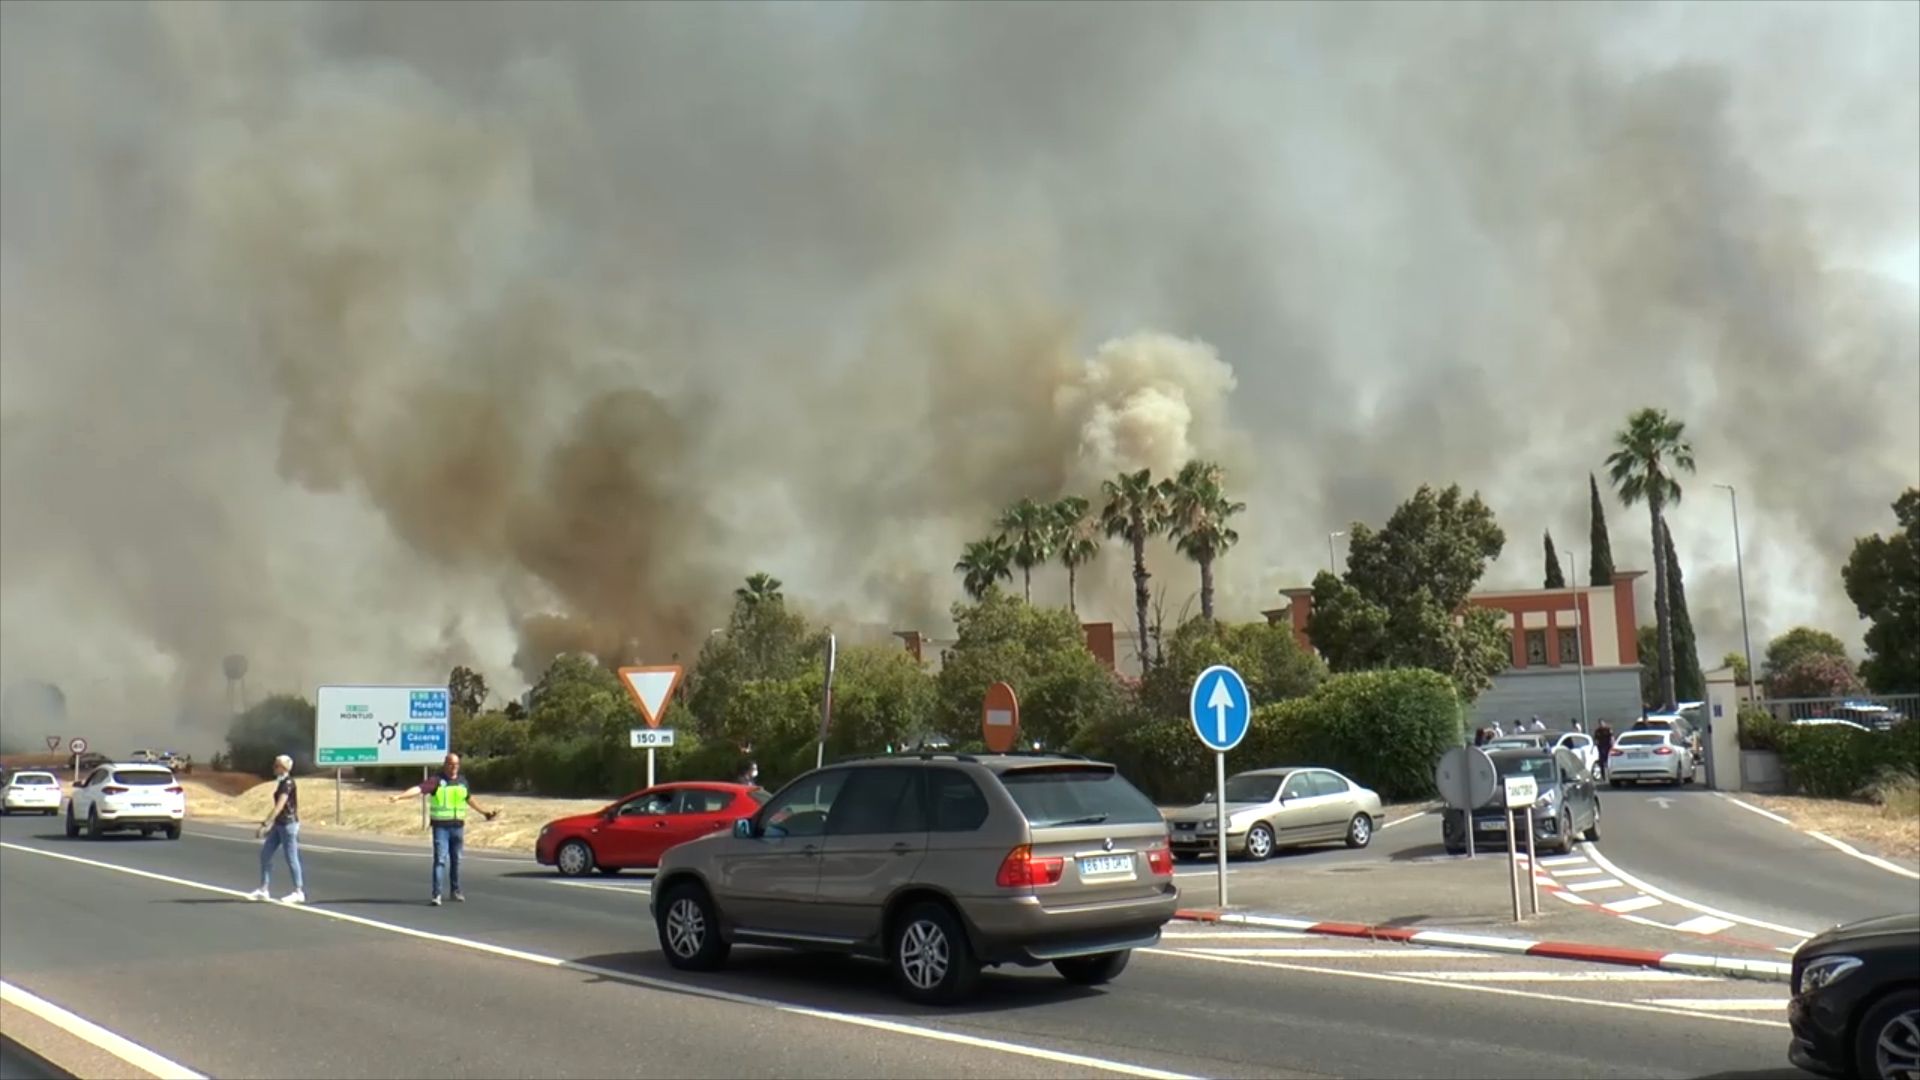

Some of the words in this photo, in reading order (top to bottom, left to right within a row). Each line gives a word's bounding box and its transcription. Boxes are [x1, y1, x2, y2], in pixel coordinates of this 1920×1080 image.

[414, 701, 443, 709] Madrid
[412, 710, 444, 719] Badajoz
[407, 733, 440, 741] Cáceres
[636, 733, 656, 744] 150
[661, 735, 671, 743] m
